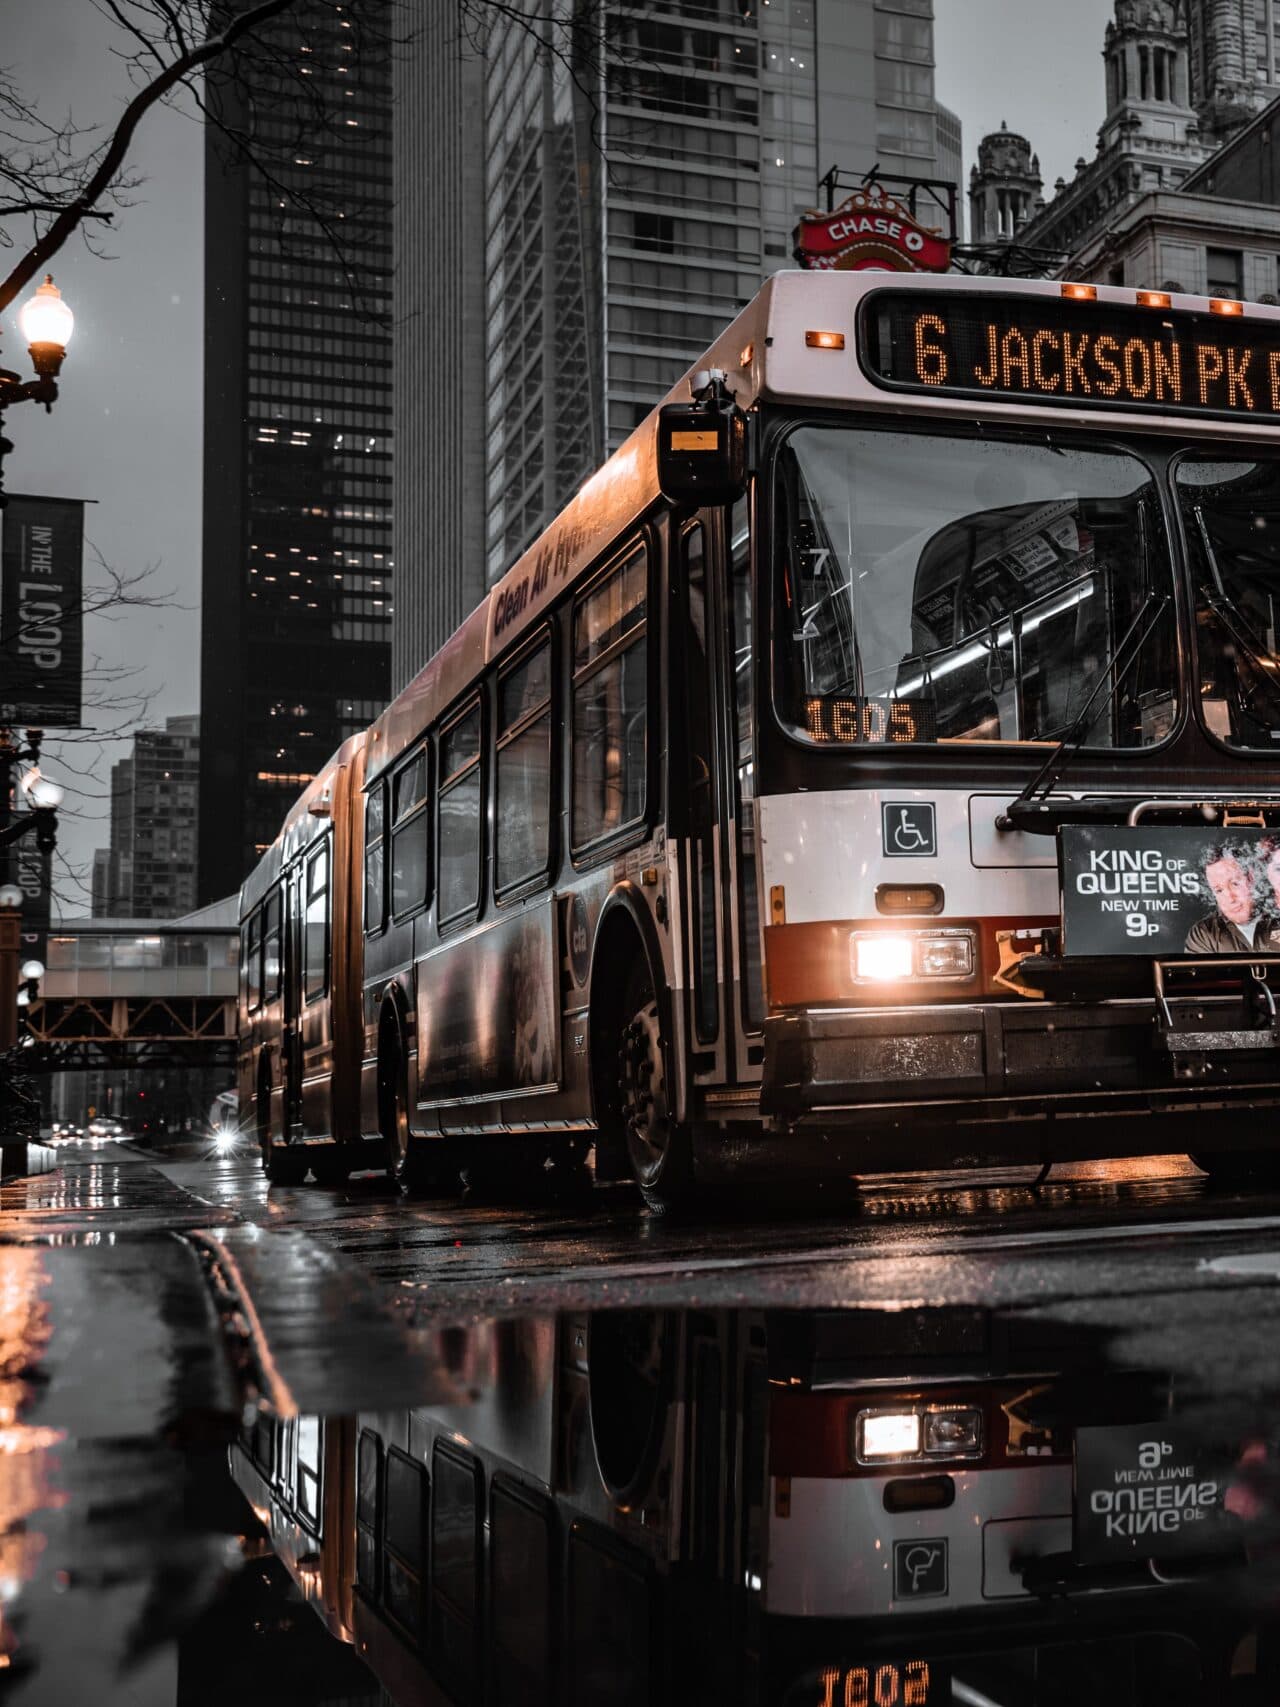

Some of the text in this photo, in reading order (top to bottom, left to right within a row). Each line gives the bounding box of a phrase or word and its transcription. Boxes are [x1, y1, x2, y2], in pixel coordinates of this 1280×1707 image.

[828, 217, 903, 241] CHASE
[914, 313, 948, 386] 6
[974, 323, 1181, 401] JACKSON
[1199, 344, 1252, 410] PK
[18, 526, 63, 669] IN THE LOOP
[494, 576, 530, 637] Clean
[530, 544, 554, 602] Air
[806, 700, 917, 742] 1605
[1090, 850, 1187, 871] KING OF
[1076, 872, 1200, 894] QUEENS
[1101, 900, 1179, 911] NEW TIME
[1126, 913, 1159, 937] 9P
[573, 926, 587, 953] cta
